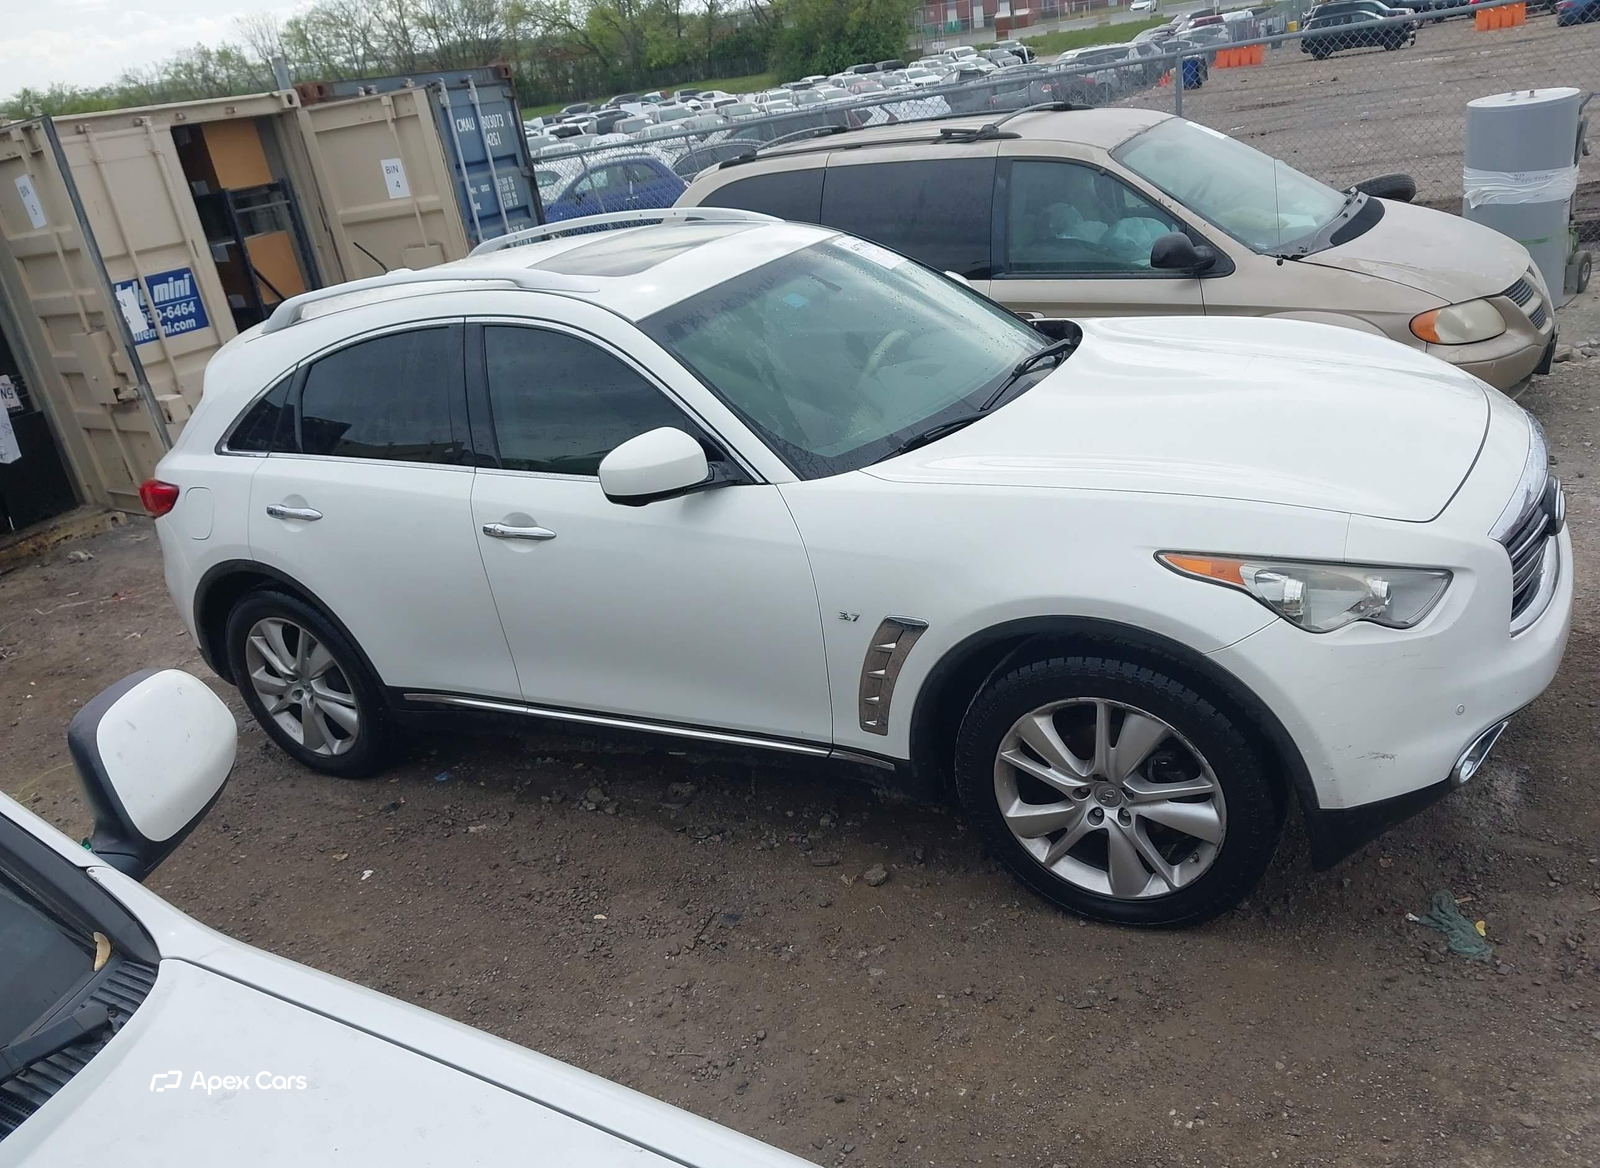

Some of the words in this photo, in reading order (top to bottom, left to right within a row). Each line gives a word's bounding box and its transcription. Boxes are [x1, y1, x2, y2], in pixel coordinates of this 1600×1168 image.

[456, 117, 475, 132] CMAU
[385, 164, 399, 174] BIN
[153, 273, 191, 303] mini
